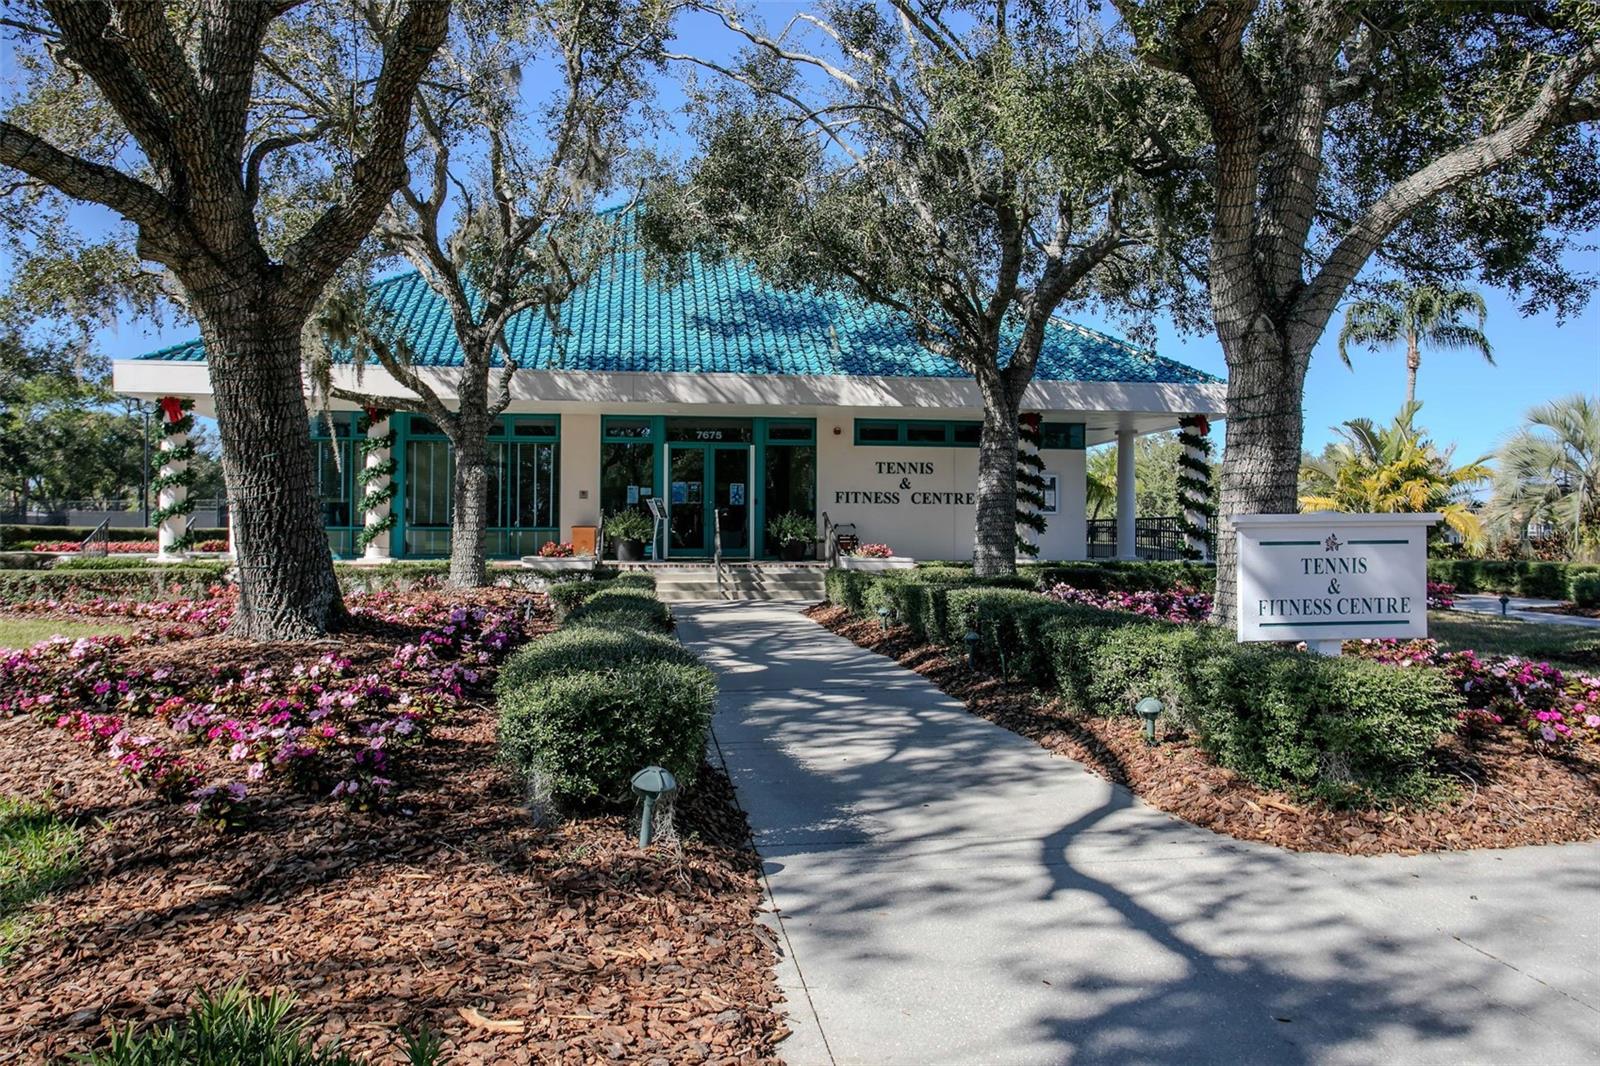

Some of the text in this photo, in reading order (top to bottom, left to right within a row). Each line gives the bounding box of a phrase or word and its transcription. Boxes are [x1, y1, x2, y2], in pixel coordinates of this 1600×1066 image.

[696, 430, 723, 440] 7675
[875, 461, 934, 474] TENNIS
[899, 477, 912, 490] &
[835, 491, 975, 505] FITNESS CENTRE
[1301, 557, 1368, 574] TENNIS
[1328, 578, 1340, 594] &
[1259, 597, 1411, 616] FITNESS CENTRE
